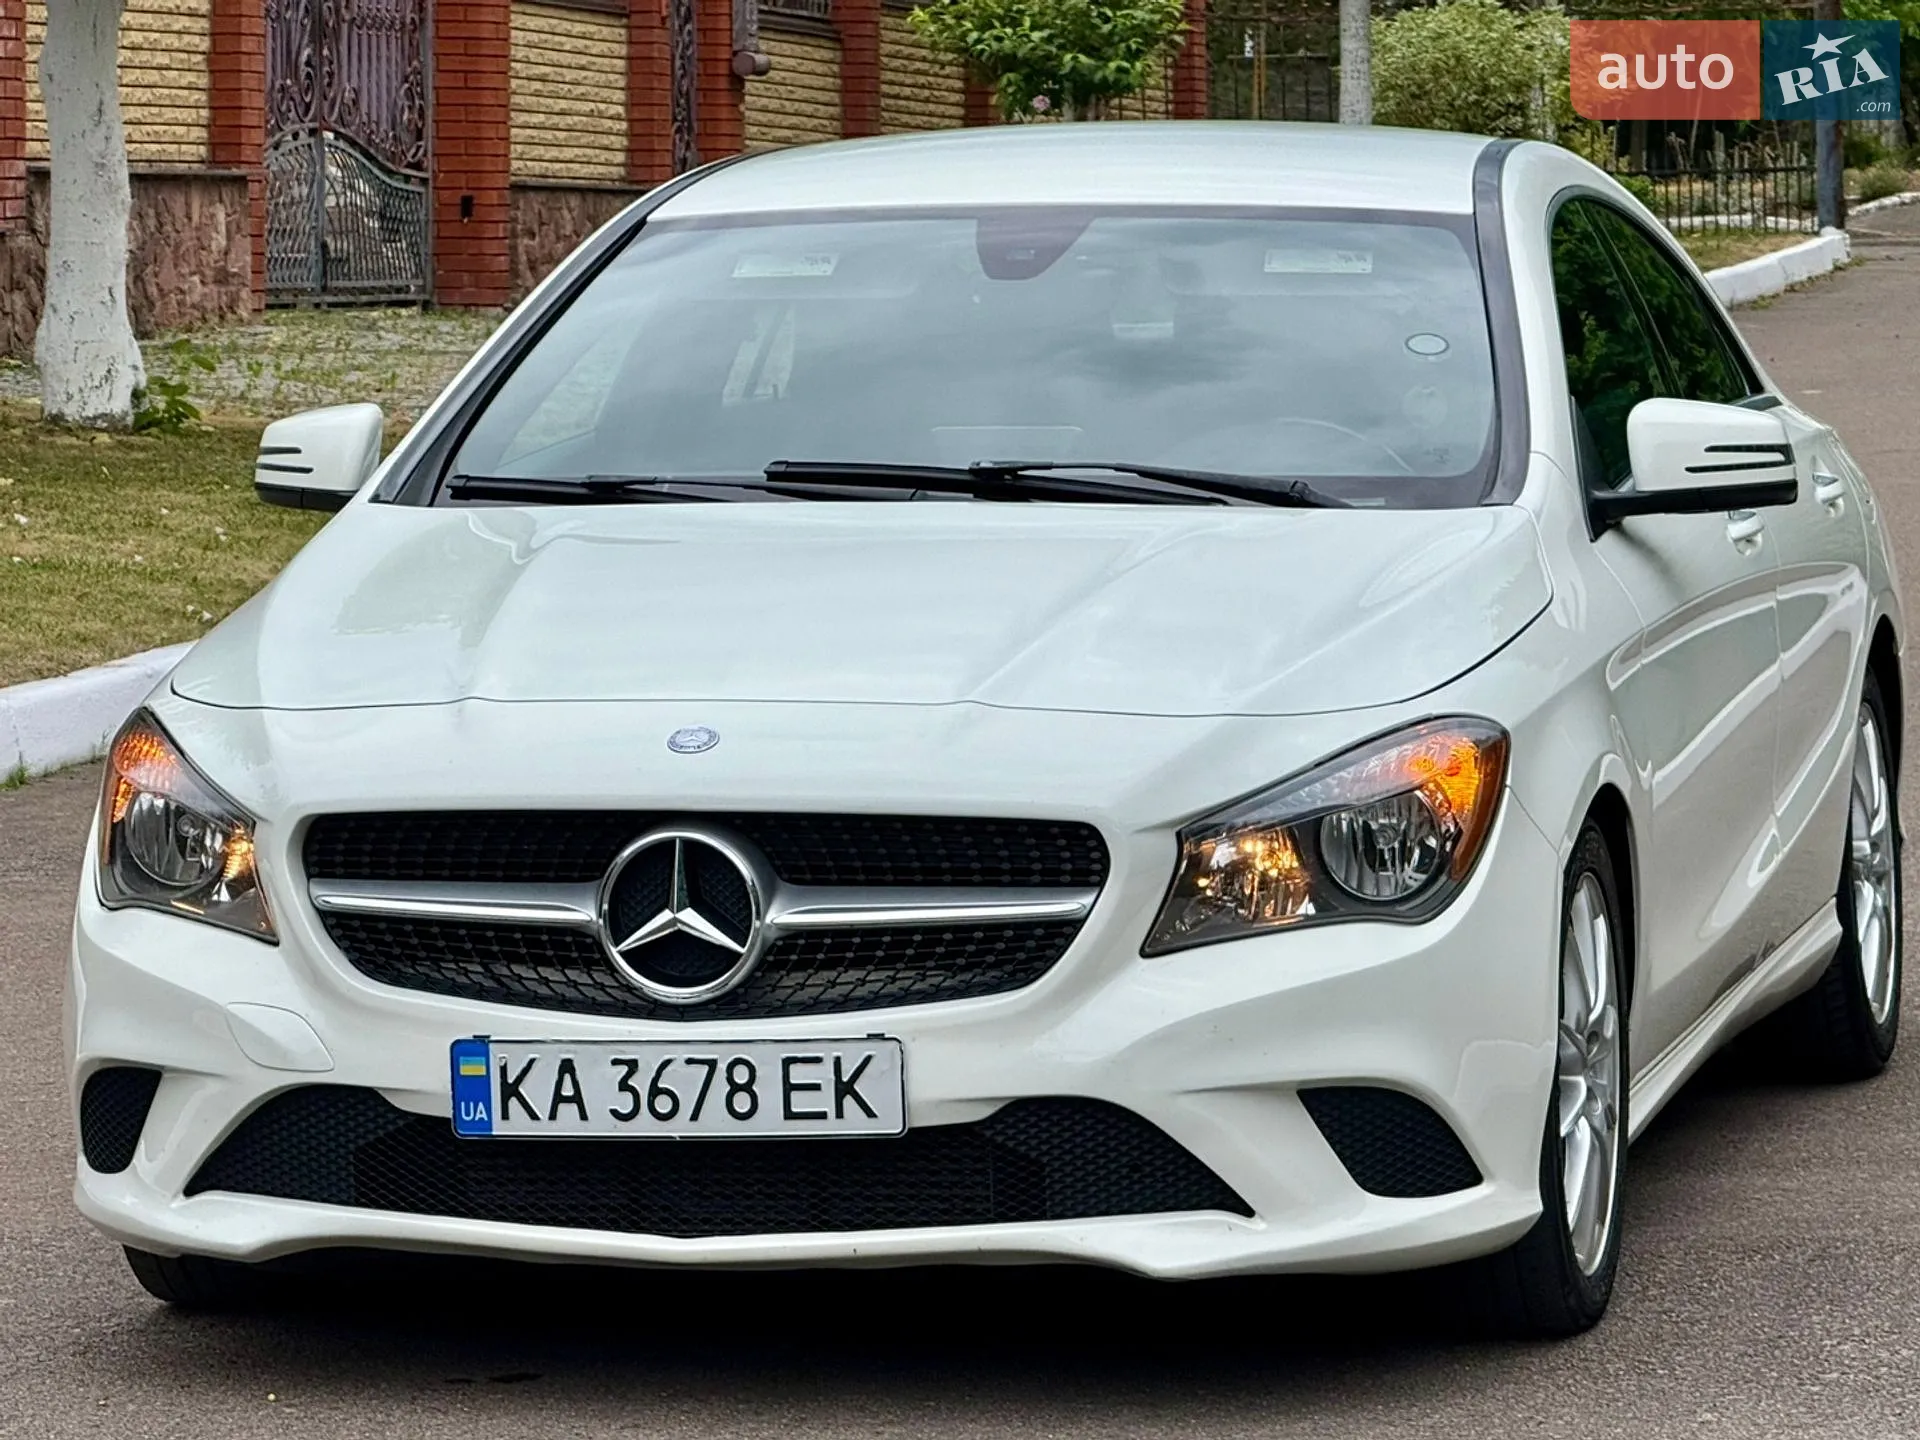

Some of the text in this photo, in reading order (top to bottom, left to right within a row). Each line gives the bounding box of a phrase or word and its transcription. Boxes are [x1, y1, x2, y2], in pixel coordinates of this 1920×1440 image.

[500, 1055, 879, 1122] KA 3678 EK
[460, 1101, 488, 1122] UA
